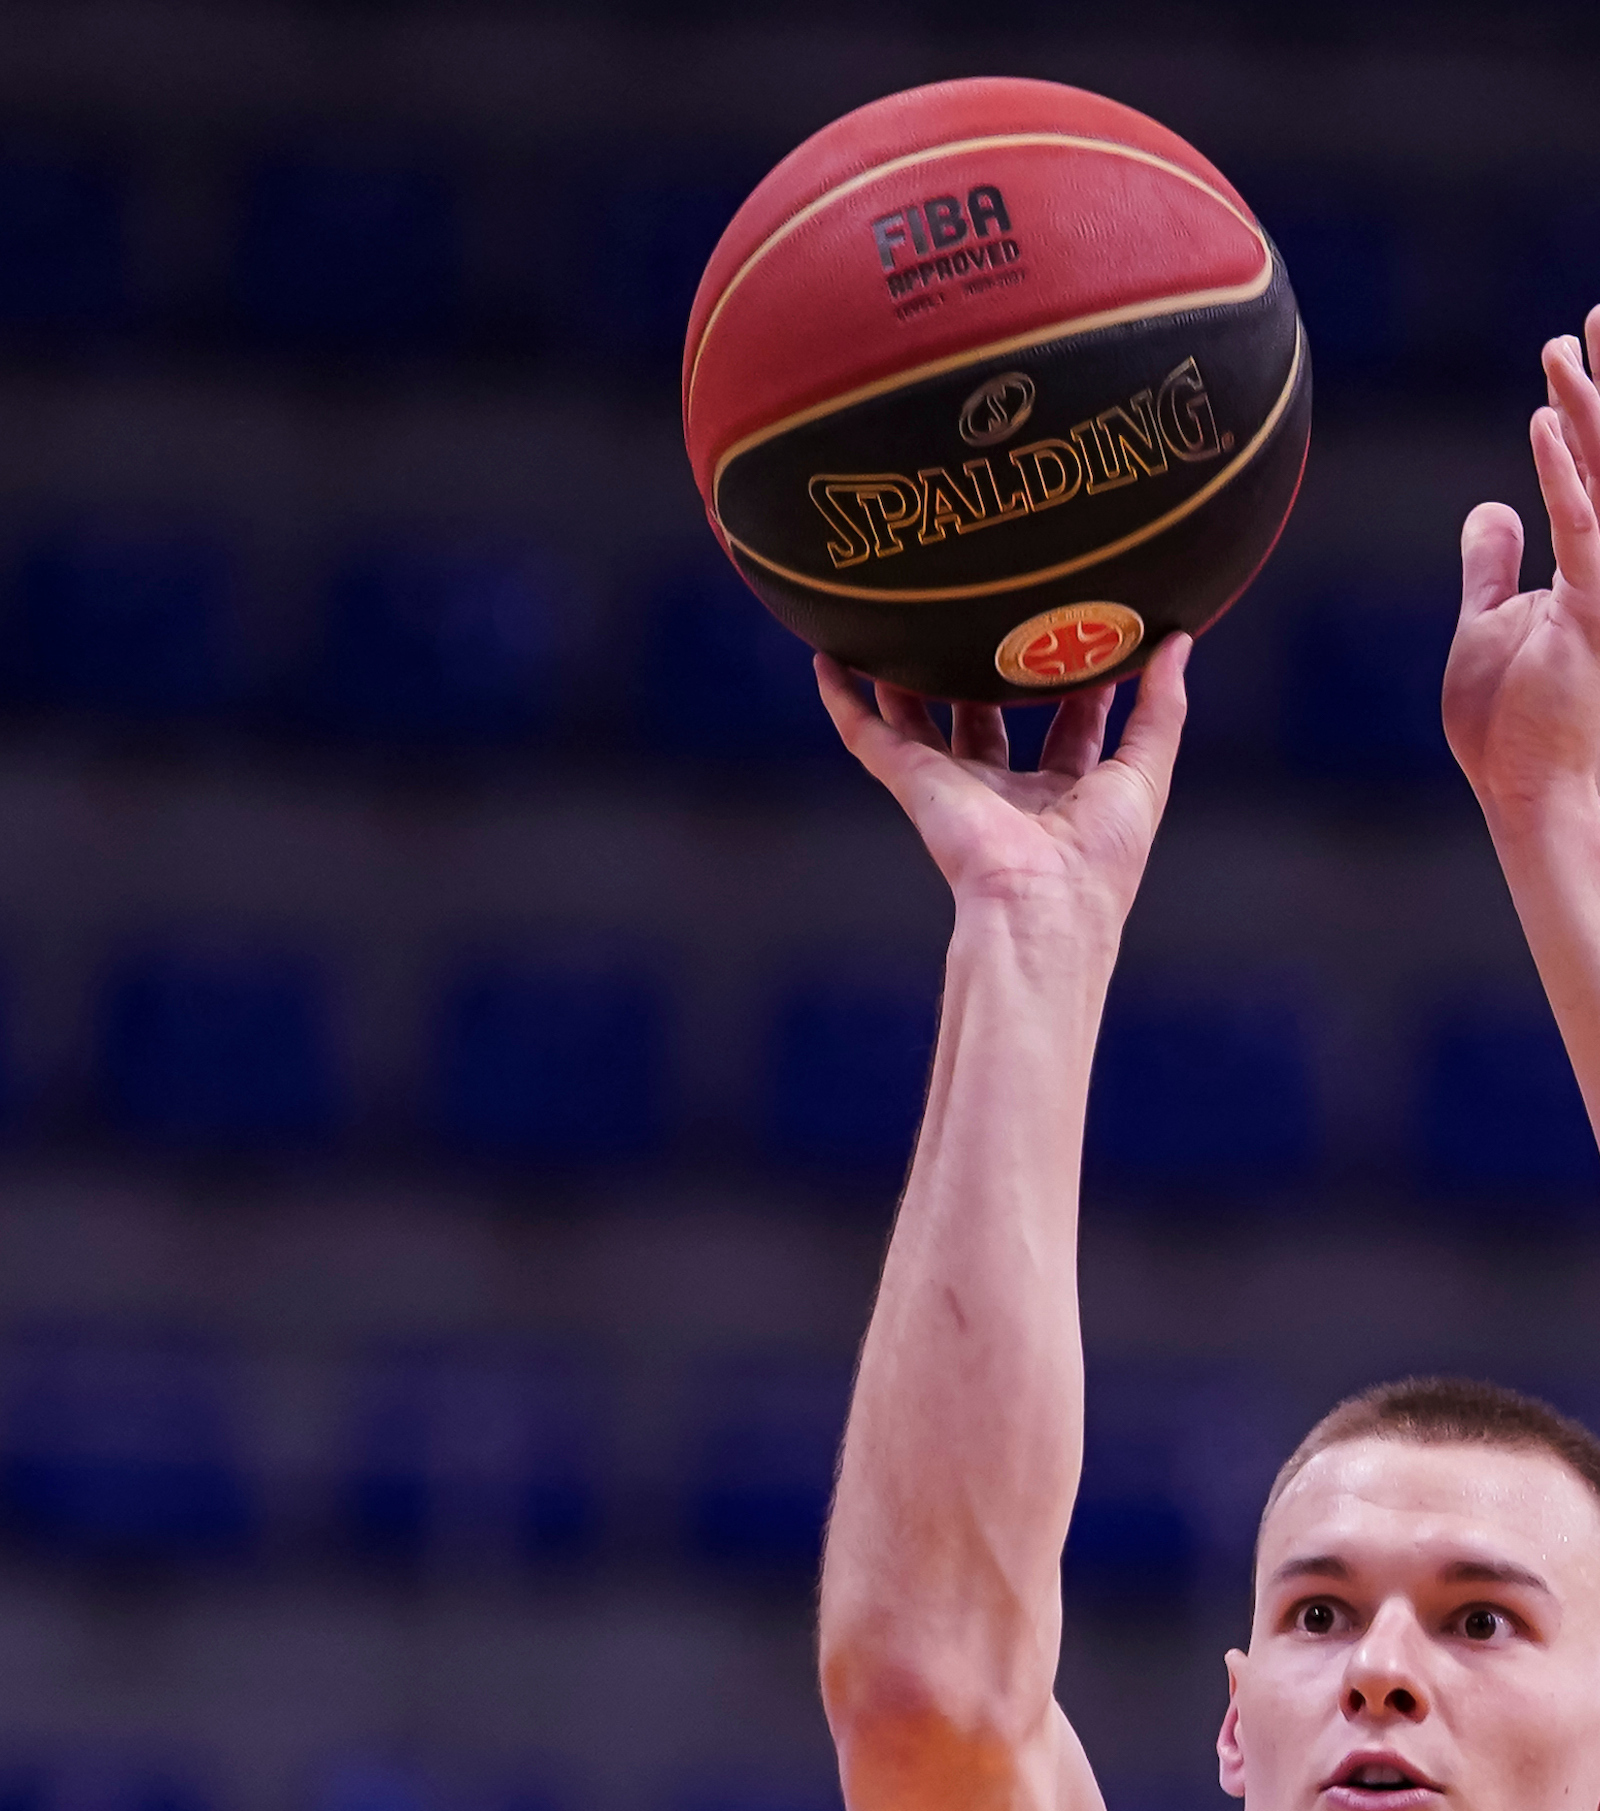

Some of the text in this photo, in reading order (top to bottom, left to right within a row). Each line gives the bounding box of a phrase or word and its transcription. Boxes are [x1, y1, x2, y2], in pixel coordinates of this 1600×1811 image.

[872, 185, 1011, 271] FIBA
[887, 239, 1020, 298] APPROVED
[809, 356, 1223, 568] SPALDING
